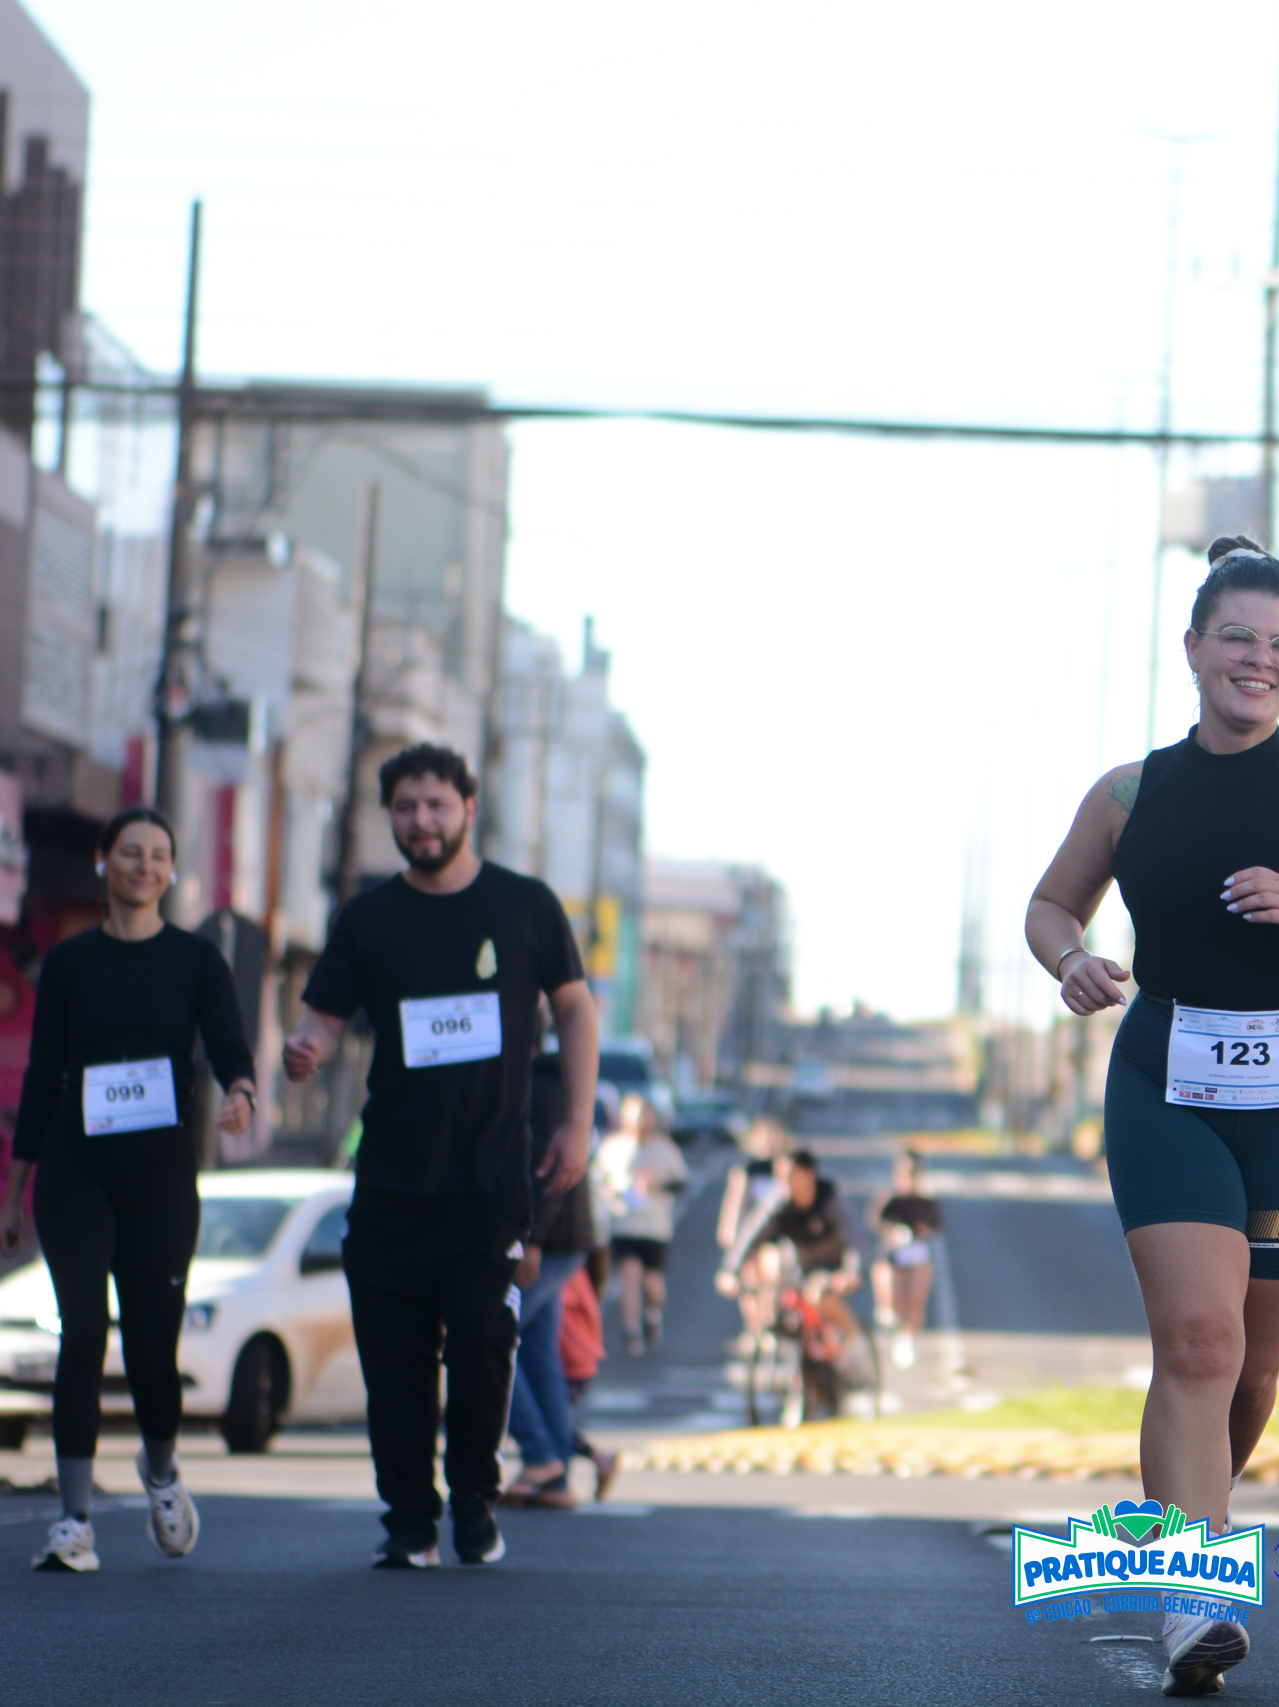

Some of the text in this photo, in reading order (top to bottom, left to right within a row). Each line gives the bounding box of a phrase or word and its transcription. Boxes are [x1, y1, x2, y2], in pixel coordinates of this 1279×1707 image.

[432, 1017, 472, 1035] 096
[1210, 1040, 1271, 1066] 123
[106, 1084, 145, 1102] 099
